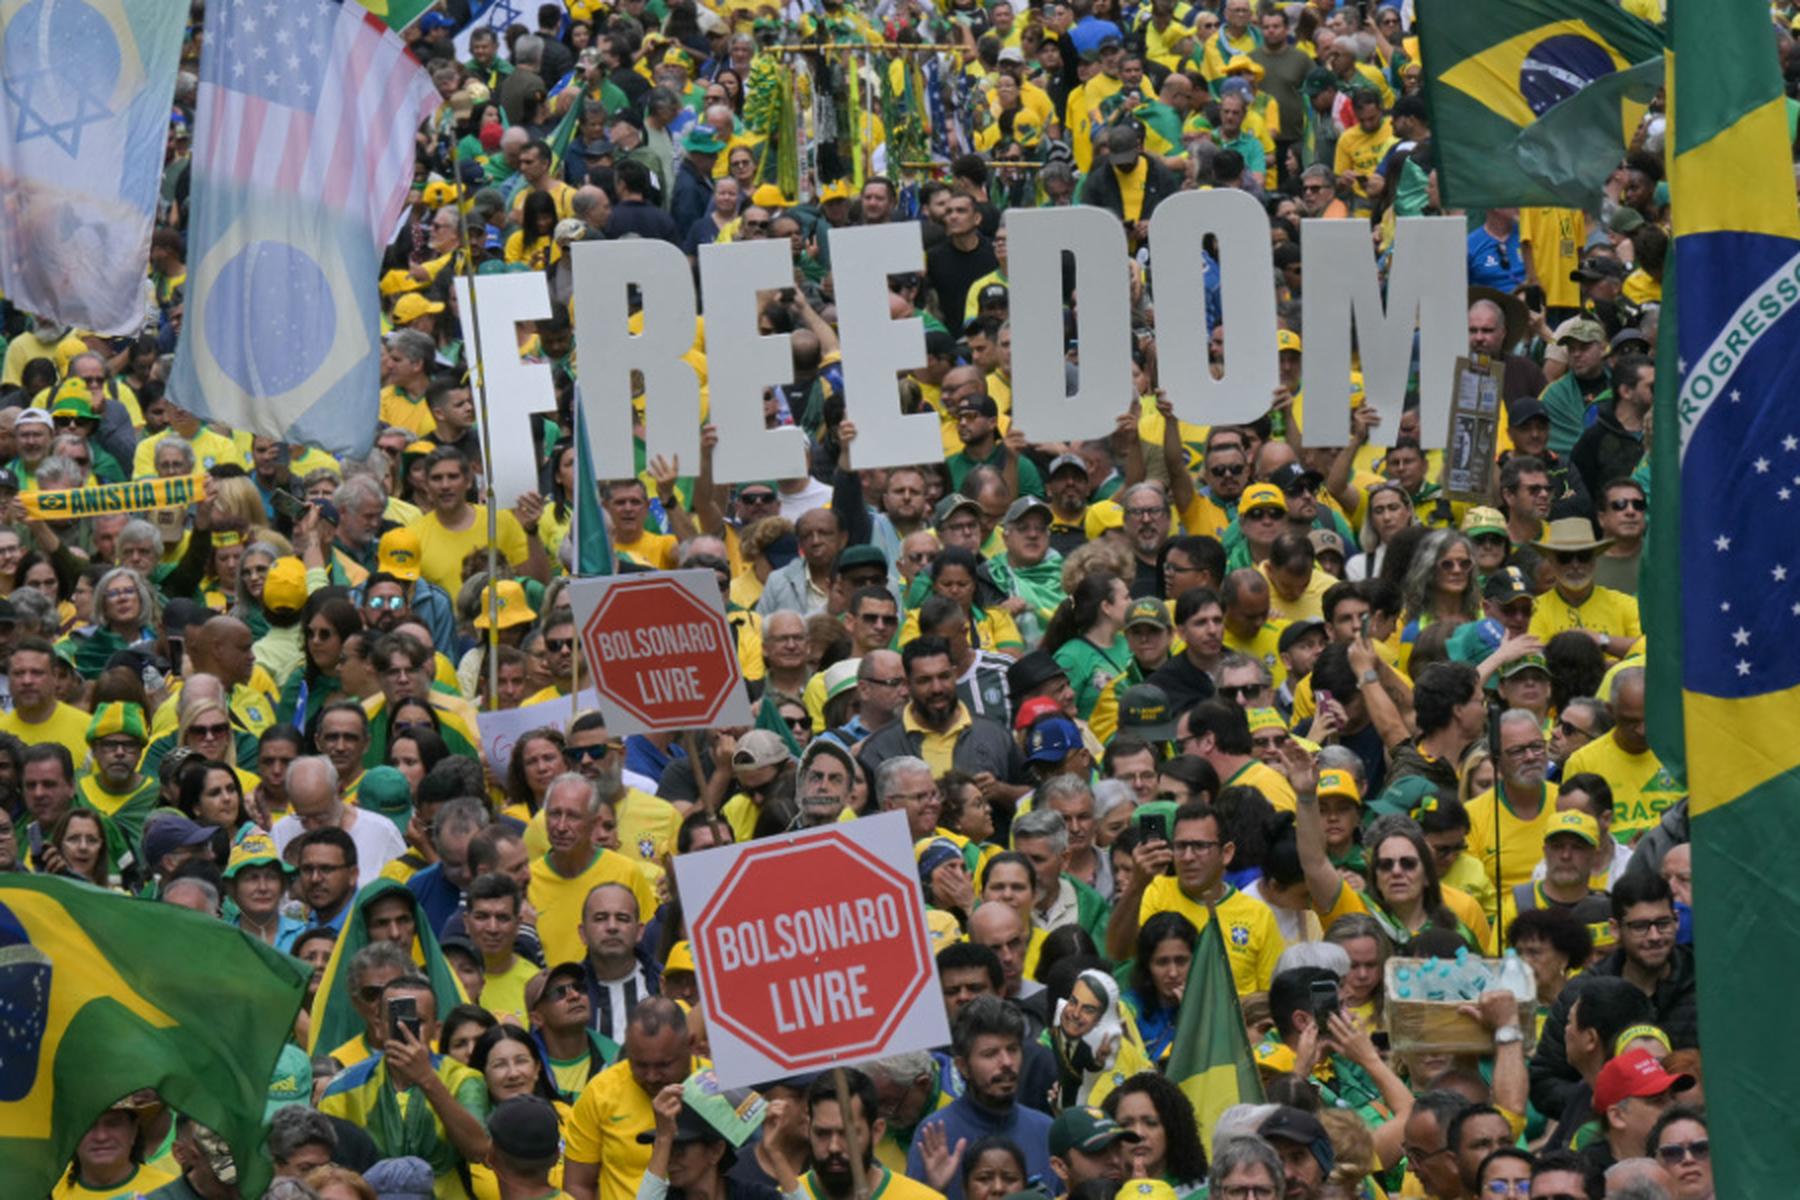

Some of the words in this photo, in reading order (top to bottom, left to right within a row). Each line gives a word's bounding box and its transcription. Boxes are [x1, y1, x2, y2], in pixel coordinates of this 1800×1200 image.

[454, 187, 1468, 509] FREEDOM
[1678, 261, 1800, 448] ROGRESS
[71, 482, 156, 515] ANISTIA
[598, 621, 718, 662] BOLSONARO
[635, 665, 706, 706] LIVRE
[715, 892, 900, 972] BOLSONARO
[769, 964, 875, 1034] LIVRE
